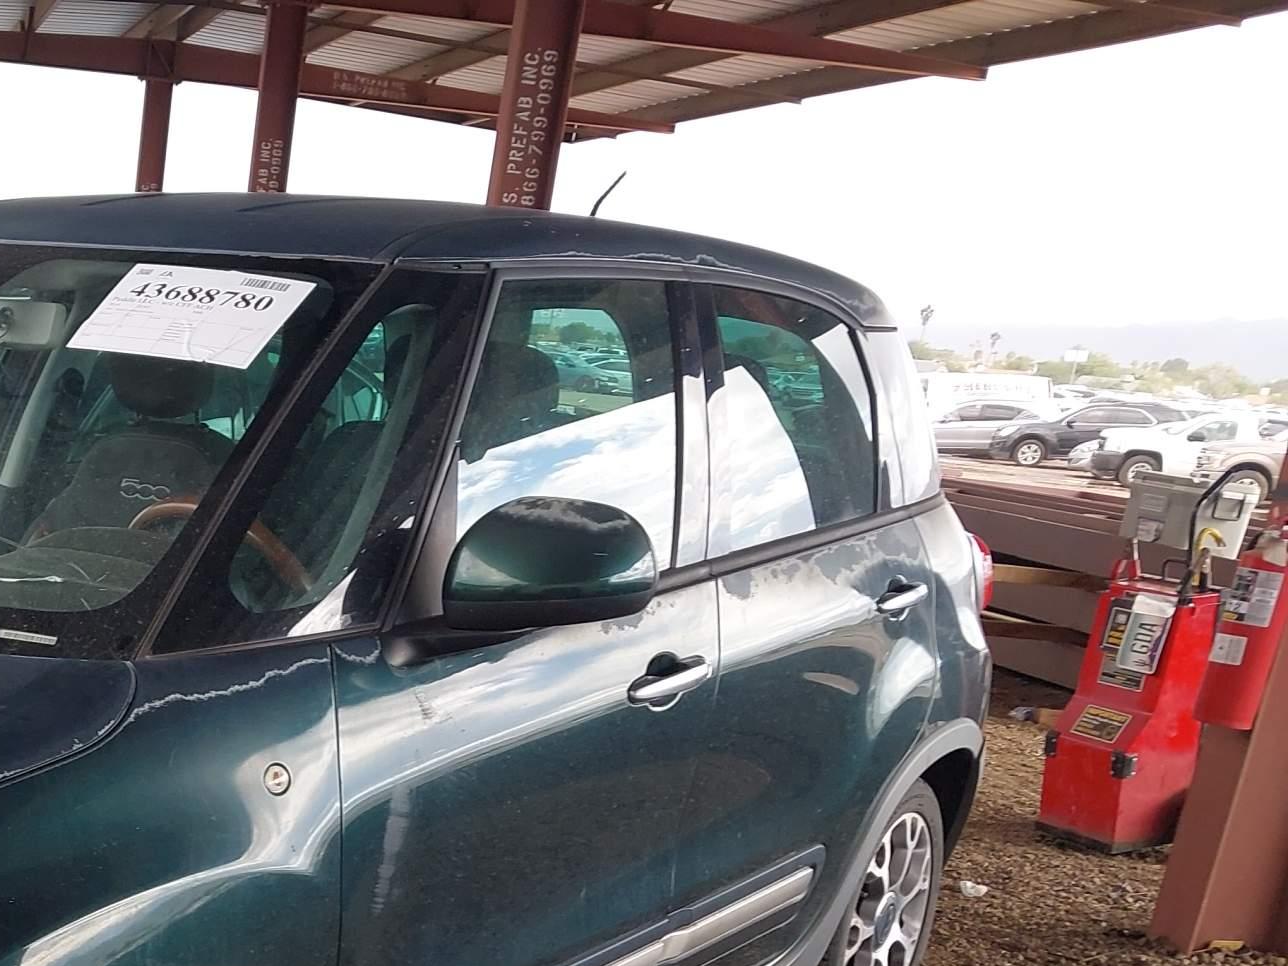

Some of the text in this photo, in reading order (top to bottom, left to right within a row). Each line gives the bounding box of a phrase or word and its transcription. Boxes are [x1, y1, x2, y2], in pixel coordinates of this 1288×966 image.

[506, 94, 533, 175] PREFAB
[523, 47, 542, 87] INC.
[259, 138, 273, 162] INC.
[129, 281, 275, 312] 43688780
